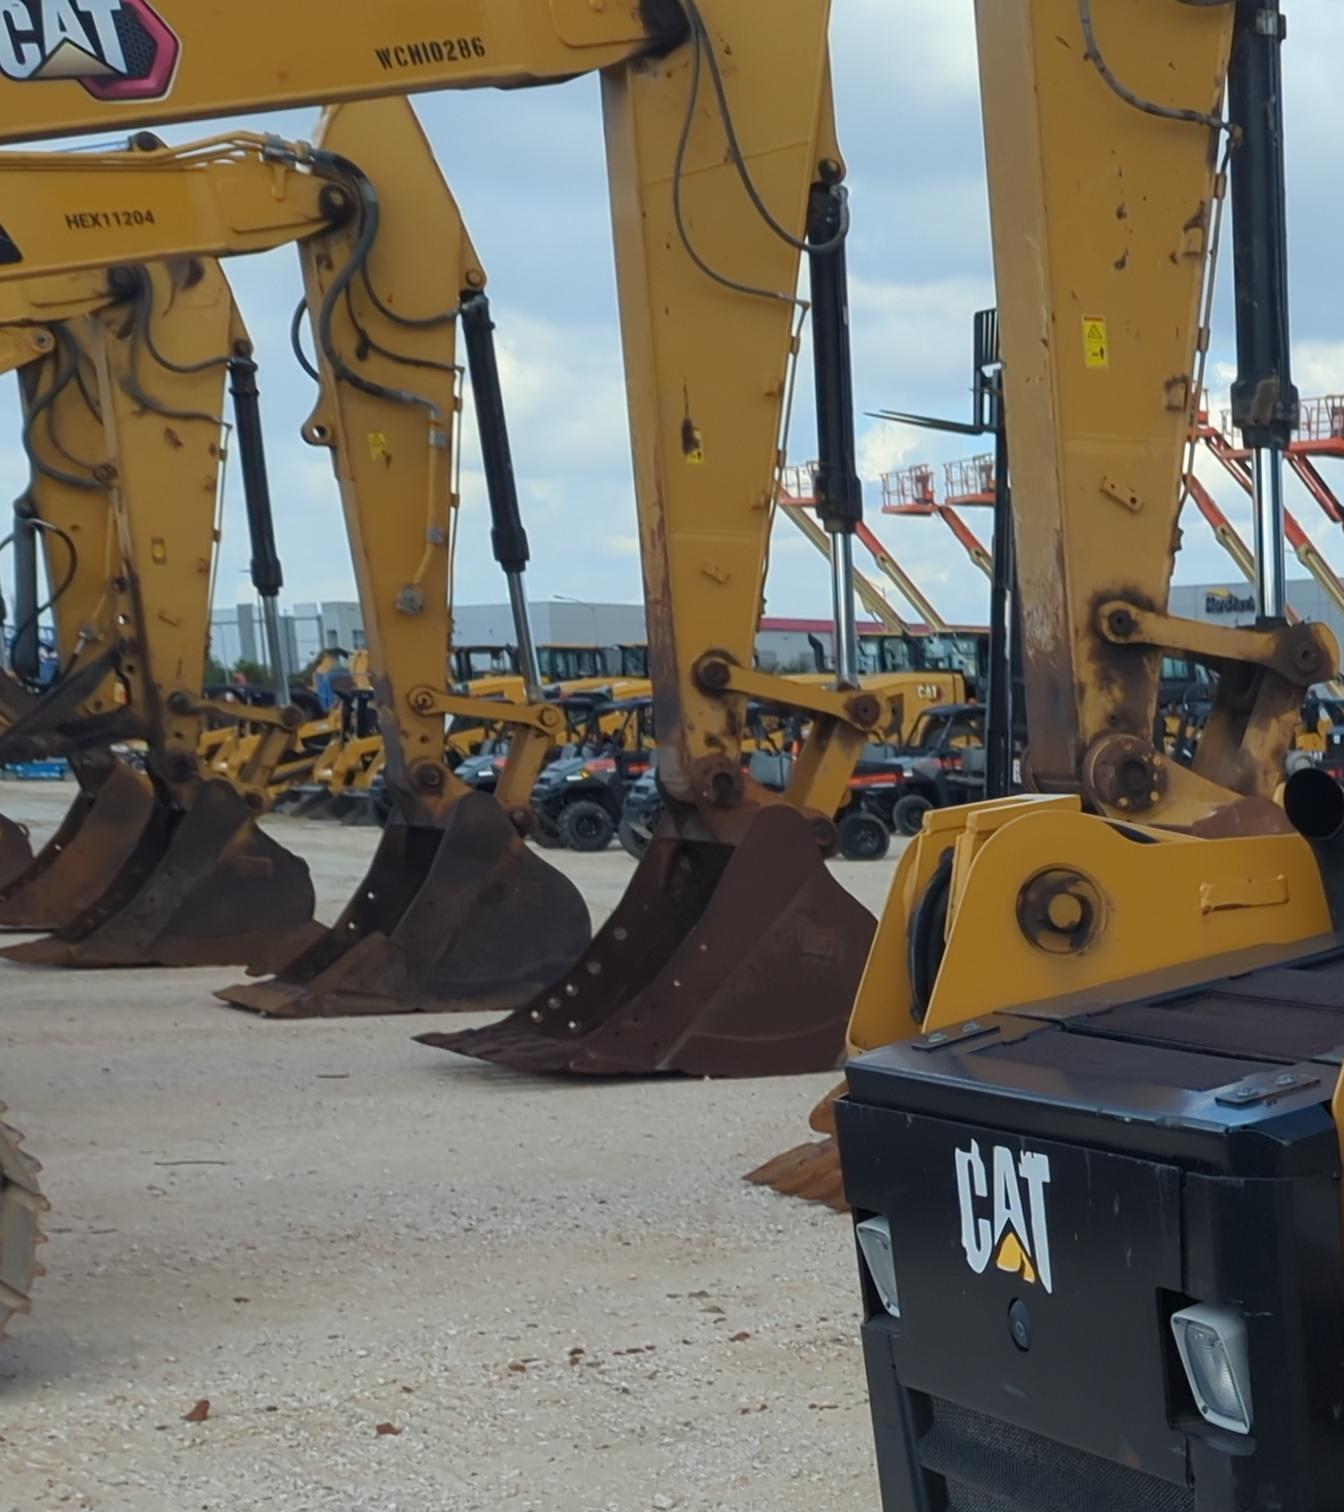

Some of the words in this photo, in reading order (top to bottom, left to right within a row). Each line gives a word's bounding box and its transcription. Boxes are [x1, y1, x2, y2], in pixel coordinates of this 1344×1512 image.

[0, 0, 128, 78] CAT
[64, 209, 156, 230] HEX11204
[917, 685, 938, 699] CAT
[955, 1138, 1052, 1294] CAT
